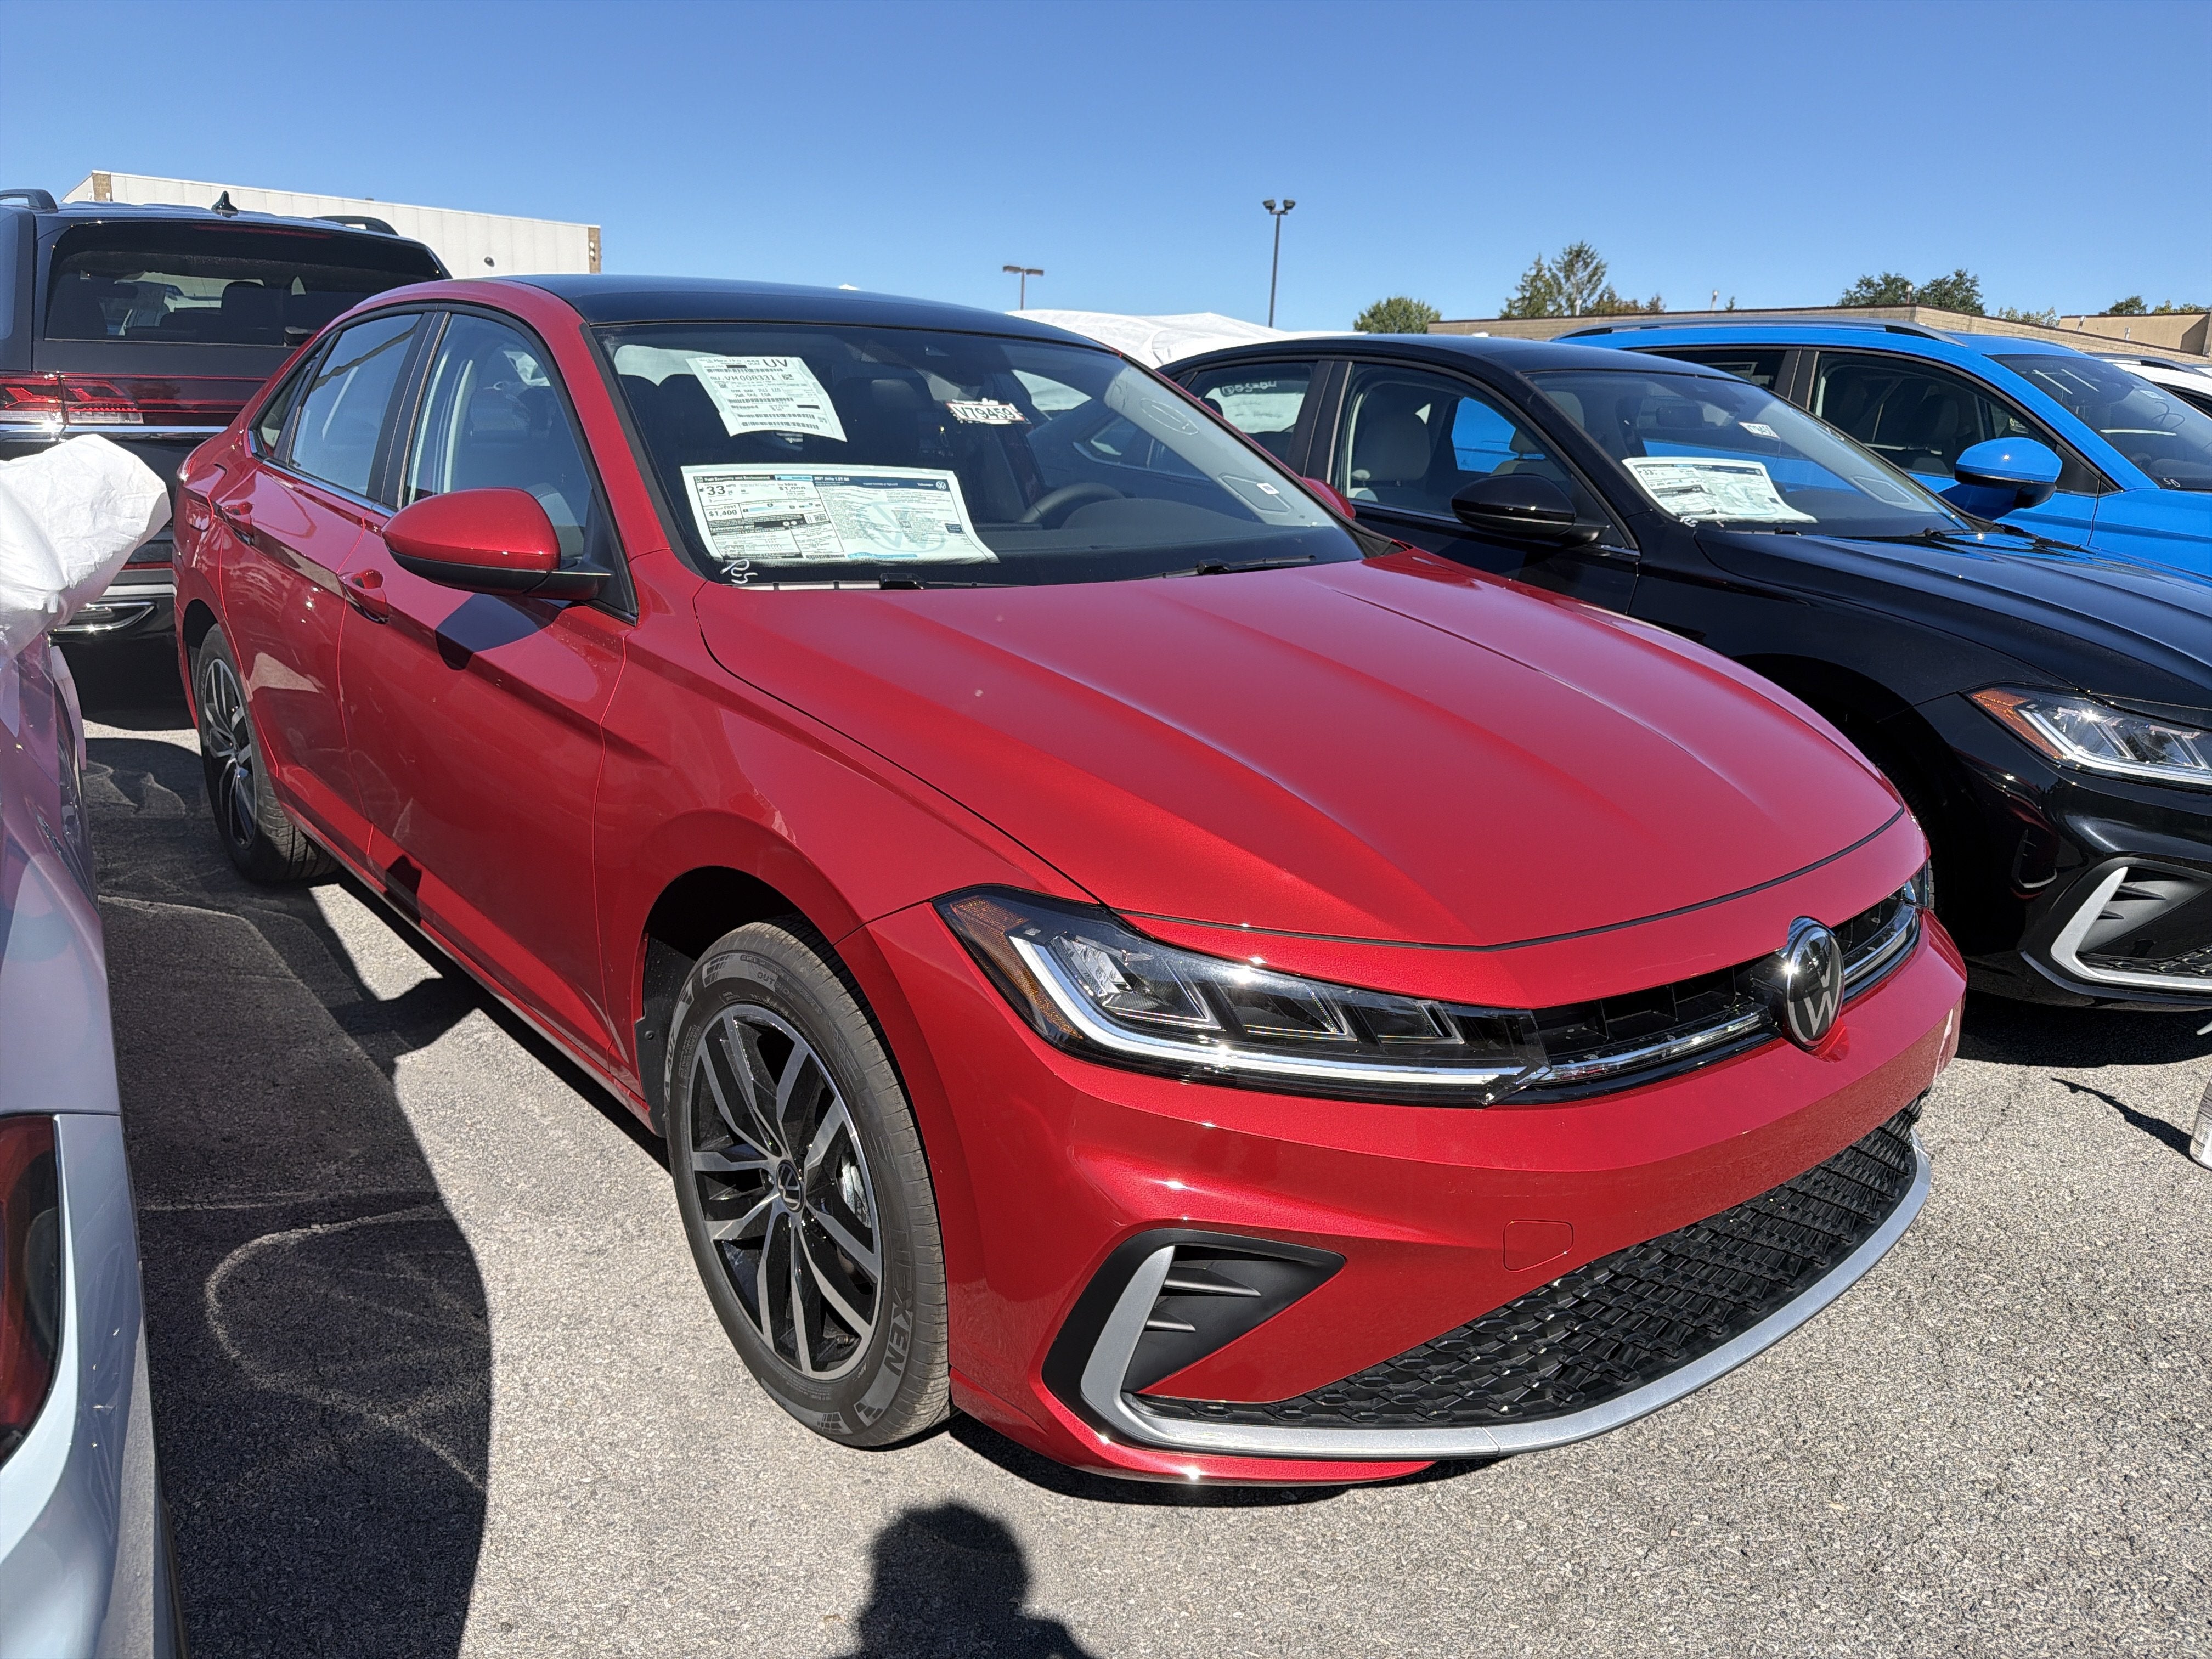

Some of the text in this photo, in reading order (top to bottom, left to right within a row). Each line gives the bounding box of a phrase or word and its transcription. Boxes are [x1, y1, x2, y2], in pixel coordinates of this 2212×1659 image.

[763, 359, 788, 367] UV
[953, 407, 1017, 419] V79459
[706, 486, 726, 495] 33
[757, 970, 797, 1002] OUTSIDE
